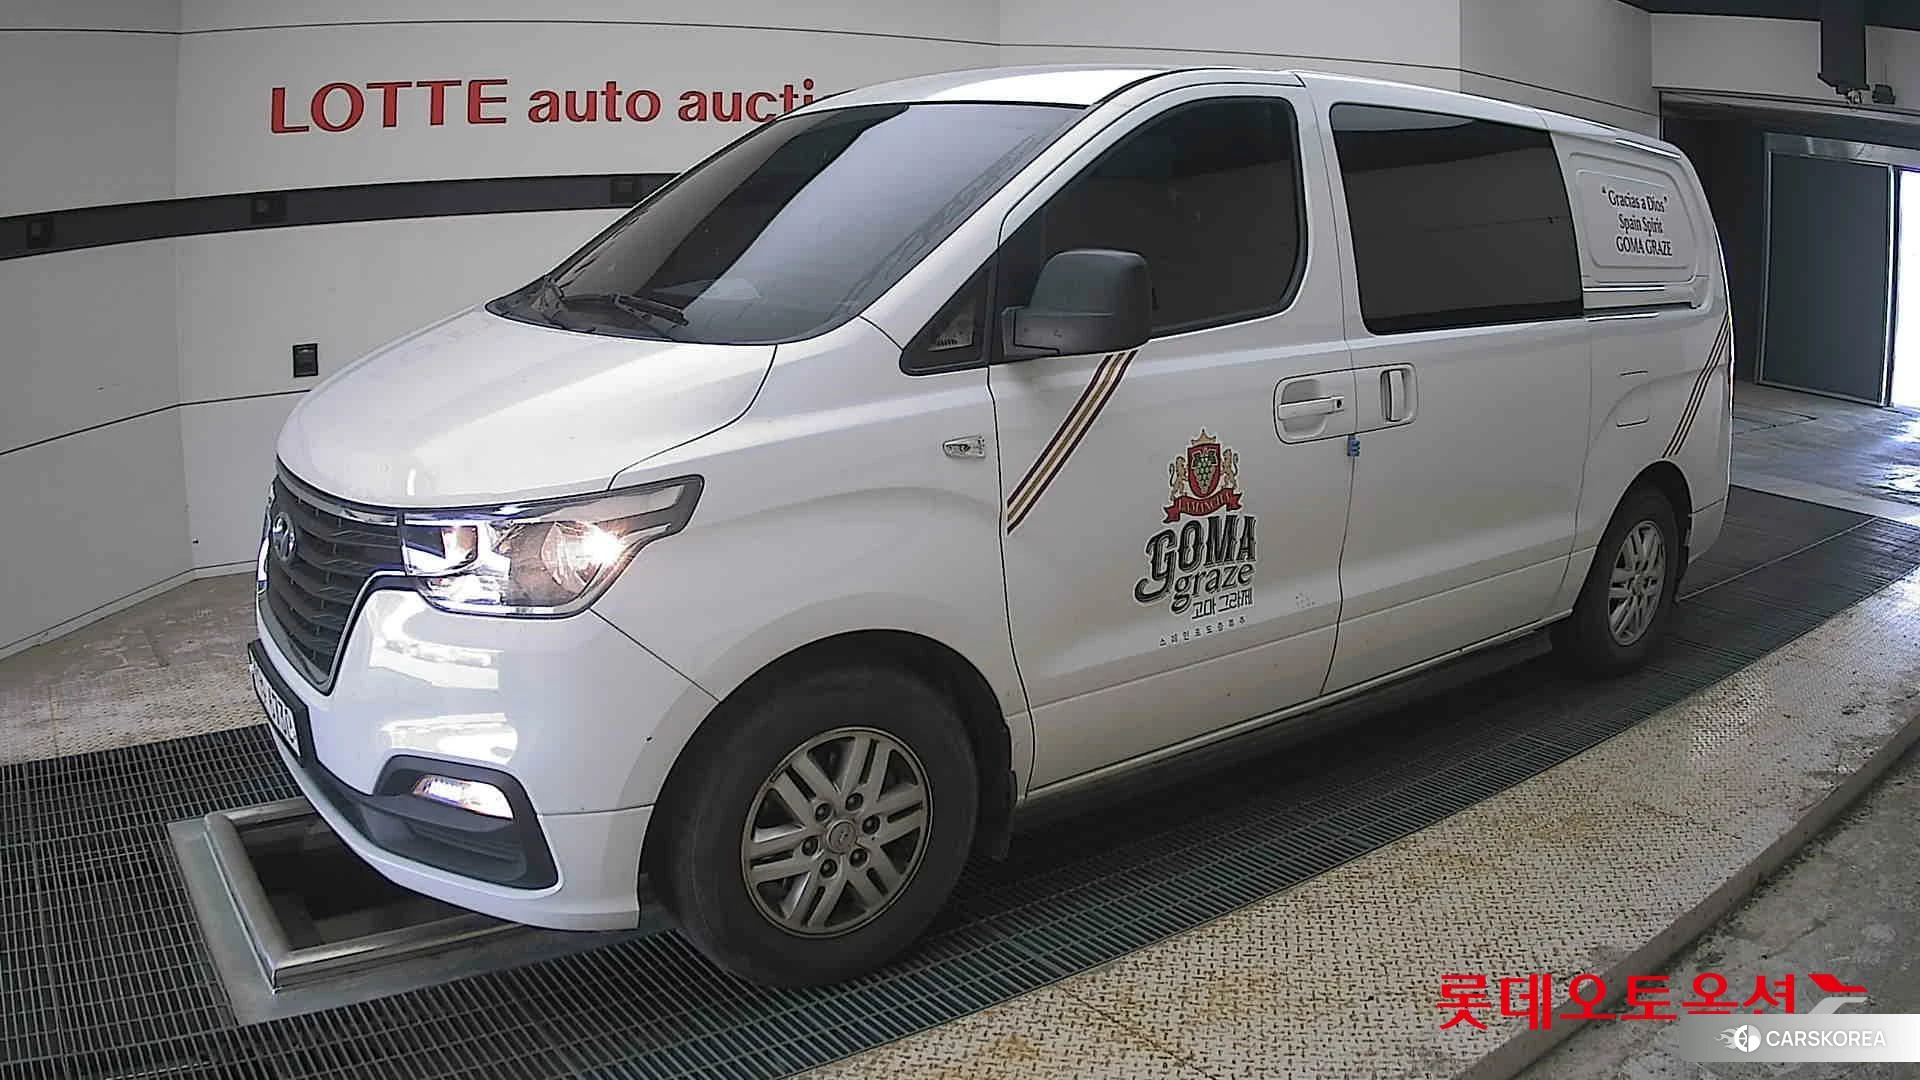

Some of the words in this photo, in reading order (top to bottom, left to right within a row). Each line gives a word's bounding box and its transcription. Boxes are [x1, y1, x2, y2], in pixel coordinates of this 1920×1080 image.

[271, 79, 508, 134] LOTTE
[528, 80, 661, 123] auto
[1641, 198, 1647, 210] a
[1619, 213, 1642, 234] Spain
[1642, 216, 1663, 237] Spirit
[1616, 236, 1645, 254] GOMA
[1645, 239, 1672, 256] GRAZE
[1134, 515, 1256, 603] GOMA
[1173, 563, 1254, 614] graze
[1192, 597, 1217, 619] 고마
